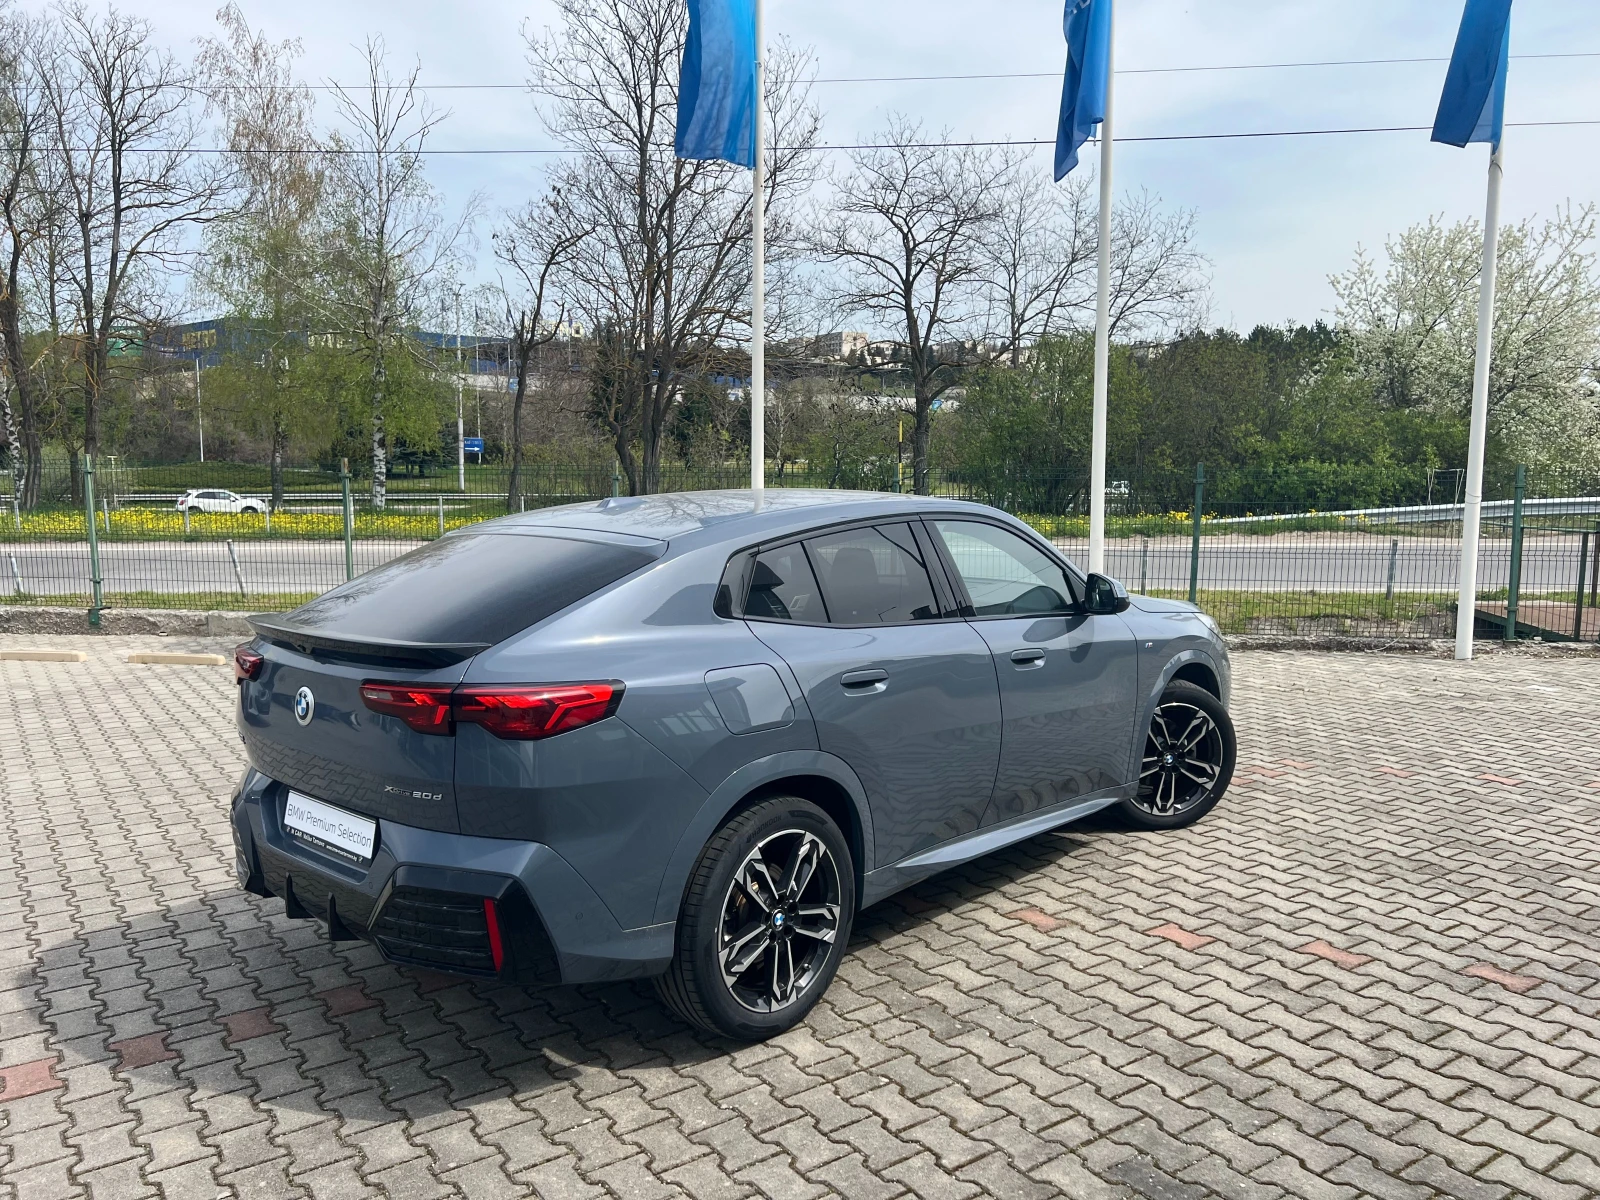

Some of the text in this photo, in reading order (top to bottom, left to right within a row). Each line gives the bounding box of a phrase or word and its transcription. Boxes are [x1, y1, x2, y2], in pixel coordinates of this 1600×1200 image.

[287, 804, 372, 848] BMW Premium Selection
